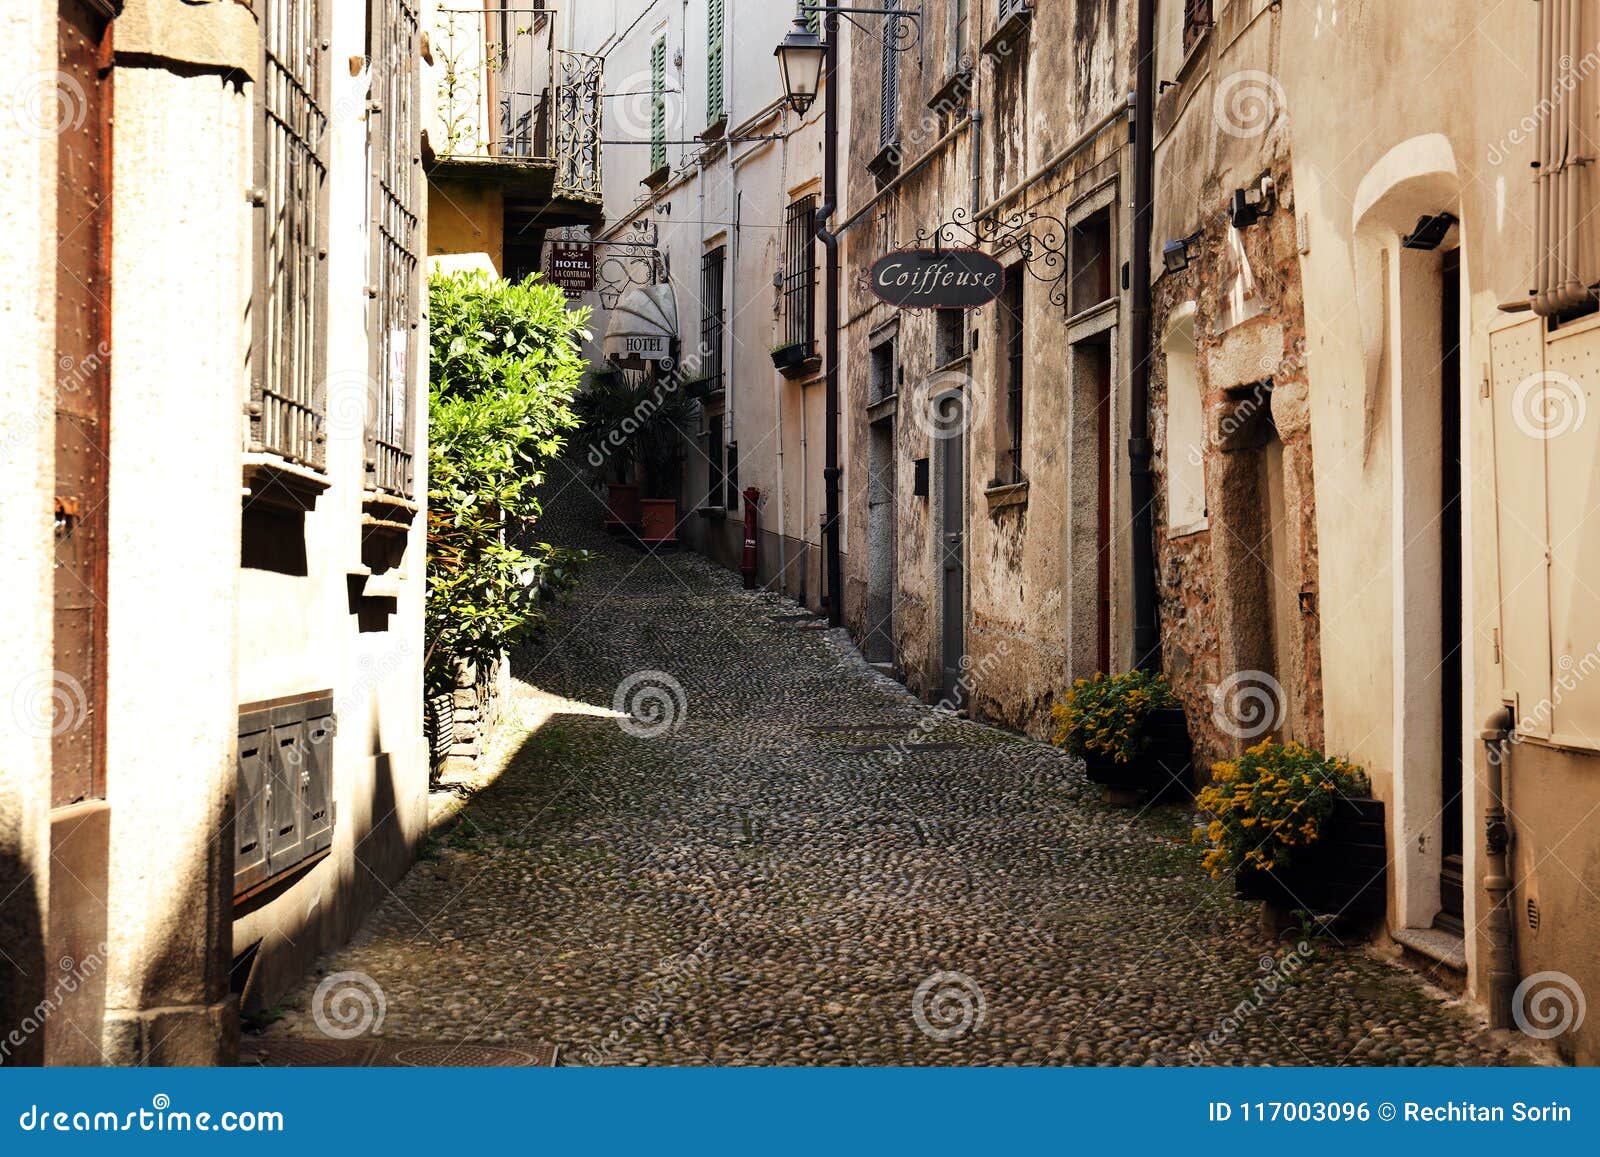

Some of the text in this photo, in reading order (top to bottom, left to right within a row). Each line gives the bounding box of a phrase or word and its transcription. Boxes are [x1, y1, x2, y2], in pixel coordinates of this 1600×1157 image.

[555, 260, 591, 269] HOTEL
[554, 269, 591, 279] LA CONTRADA
[878, 263, 997, 294] Coiffeuse
[626, 338, 664, 352] HOTEL
